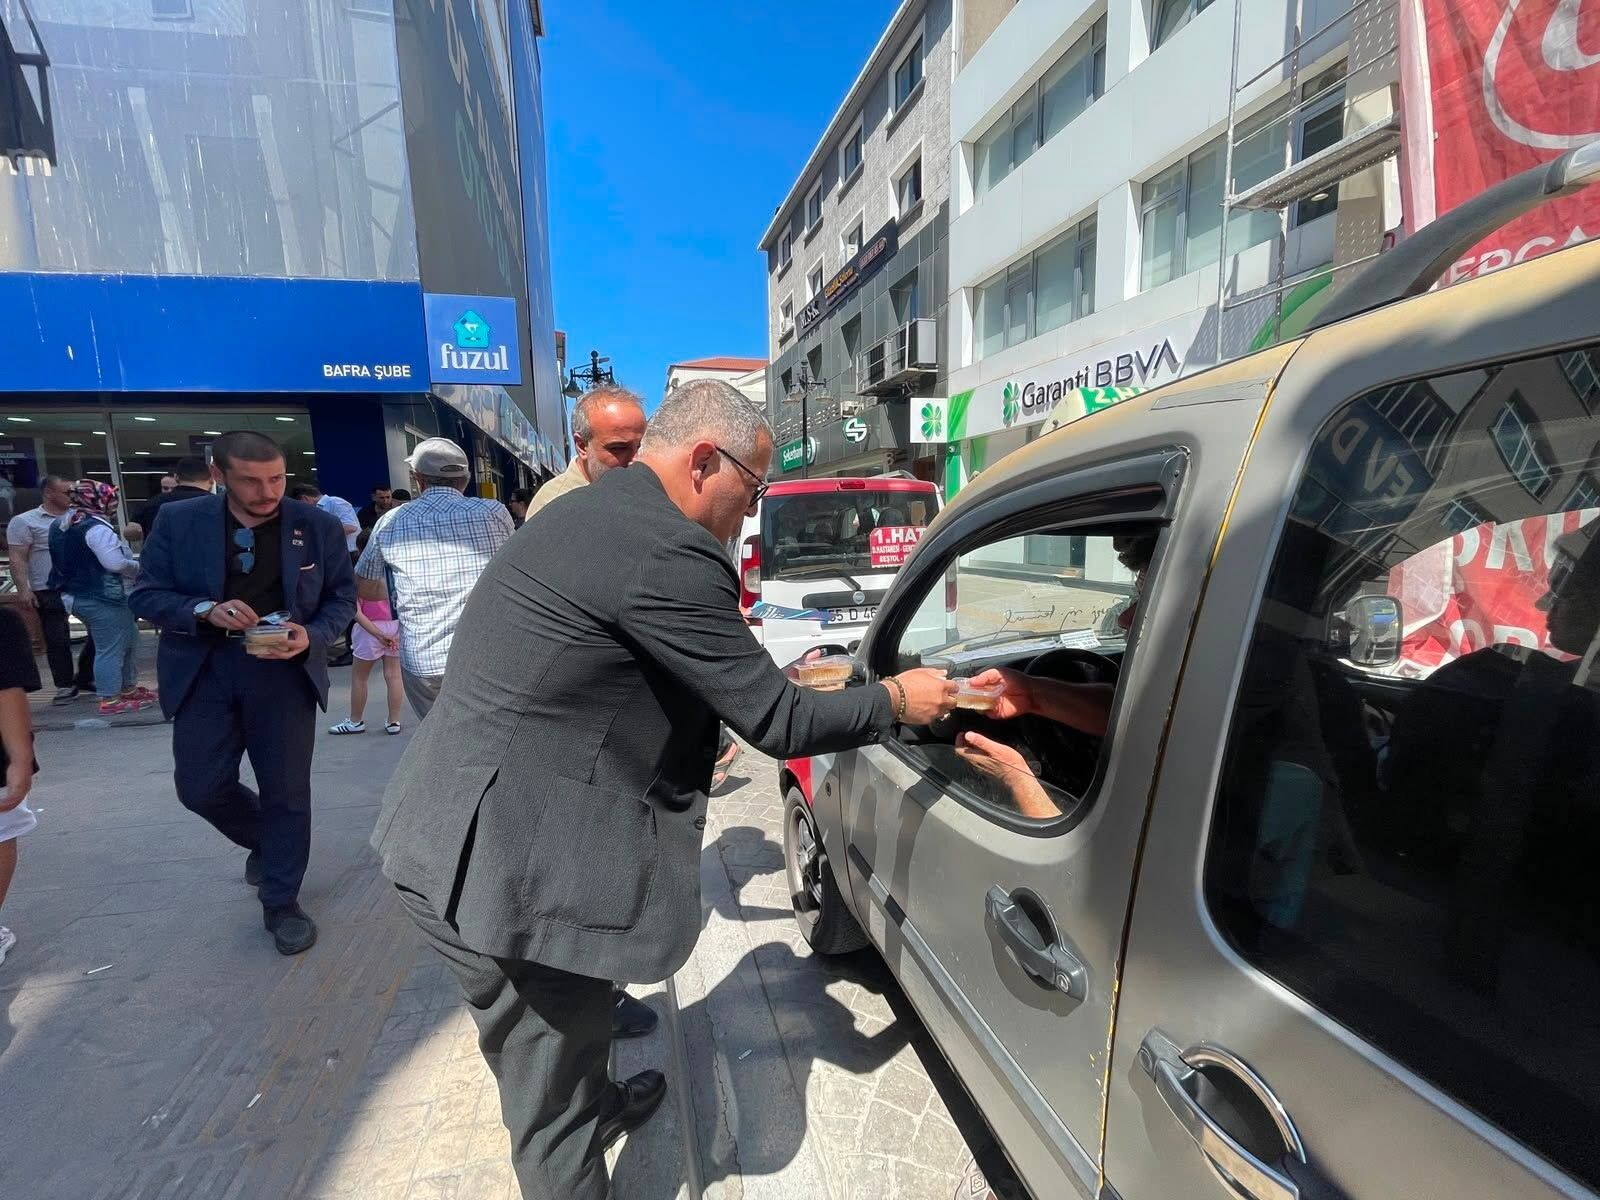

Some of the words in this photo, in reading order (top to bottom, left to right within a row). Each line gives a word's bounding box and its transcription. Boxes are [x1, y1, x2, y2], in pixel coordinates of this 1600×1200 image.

[440, 343, 509, 371] fuzul
[323, 365, 371, 377] BAFRA
[374, 365, 411, 380] ŞUBE
[1022, 366, 1089, 408] Garanti
[1095, 337, 1179, 387] BBVA
[849, 608, 858, 620] D
